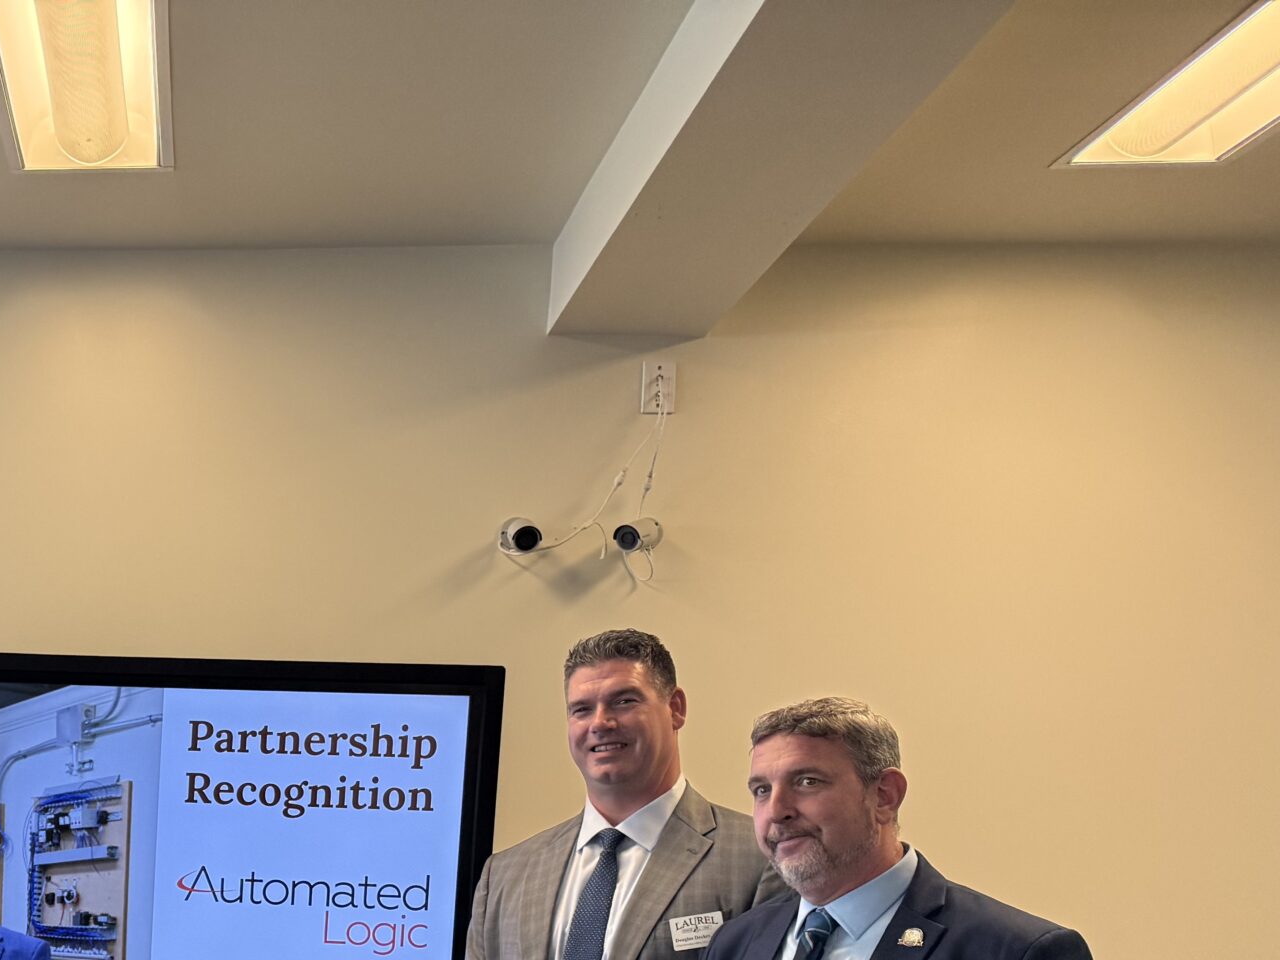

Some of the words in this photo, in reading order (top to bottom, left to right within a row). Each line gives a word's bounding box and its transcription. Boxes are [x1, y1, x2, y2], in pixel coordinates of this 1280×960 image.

[188, 719, 438, 769] Partnership
[184, 771, 435, 818] Recognition
[180, 865, 431, 911] Automated
[323, 911, 429, 956] Logic
[675, 916, 718, 930] LAUREL
